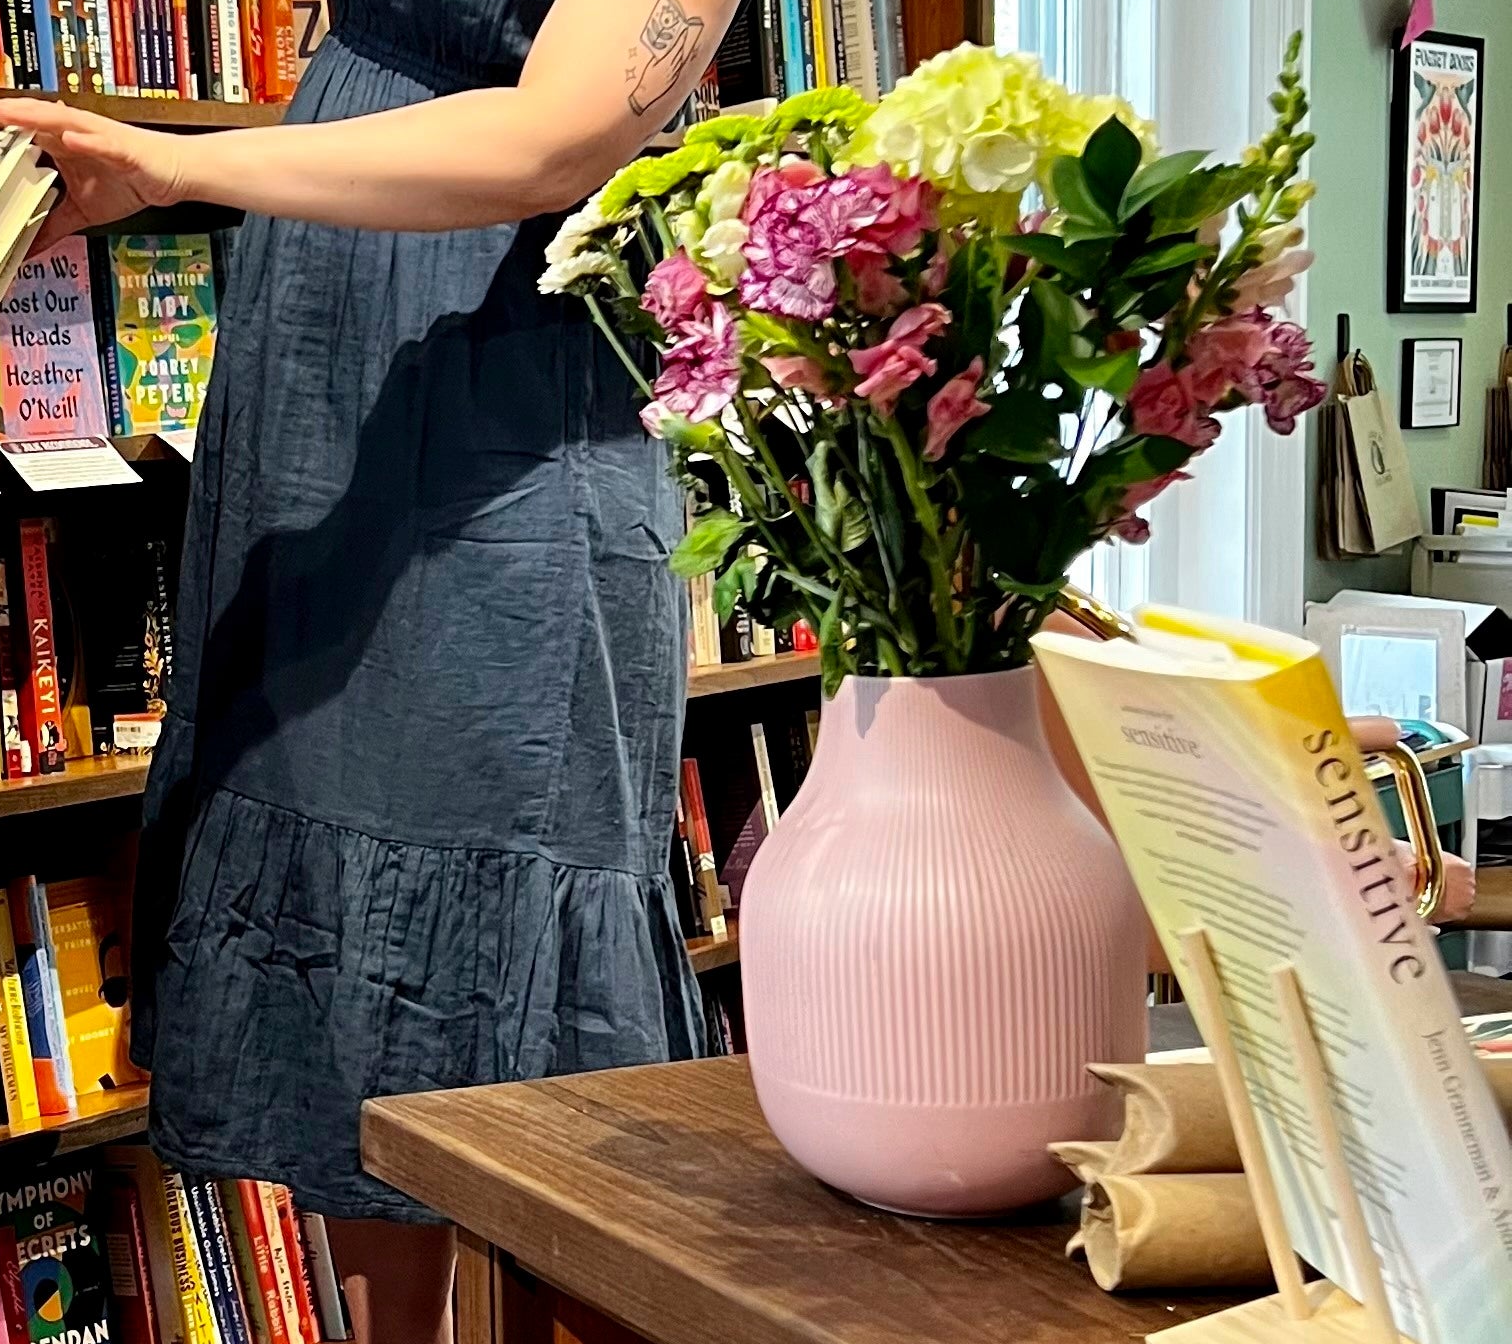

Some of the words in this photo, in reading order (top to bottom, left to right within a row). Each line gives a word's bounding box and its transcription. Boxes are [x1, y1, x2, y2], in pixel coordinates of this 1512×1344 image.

[228, 32, 239, 81] HEARTS
[51, 255, 78, 279] We
[45, 290, 79, 312] Our
[137, 294, 189, 319] BABY
[12, 324, 71, 346] Heads
[6, 361, 83, 386] Heather
[138, 358, 200, 377] TORREY
[136, 383, 207, 407] PETERS
[19, 396, 79, 421] O'Neill
[33, 617, 56, 715] KAIKEYI
[1120, 719, 1204, 762] sensitive
[1302, 726, 1428, 989] sensitive
[34, 1211, 53, 1230] OF
